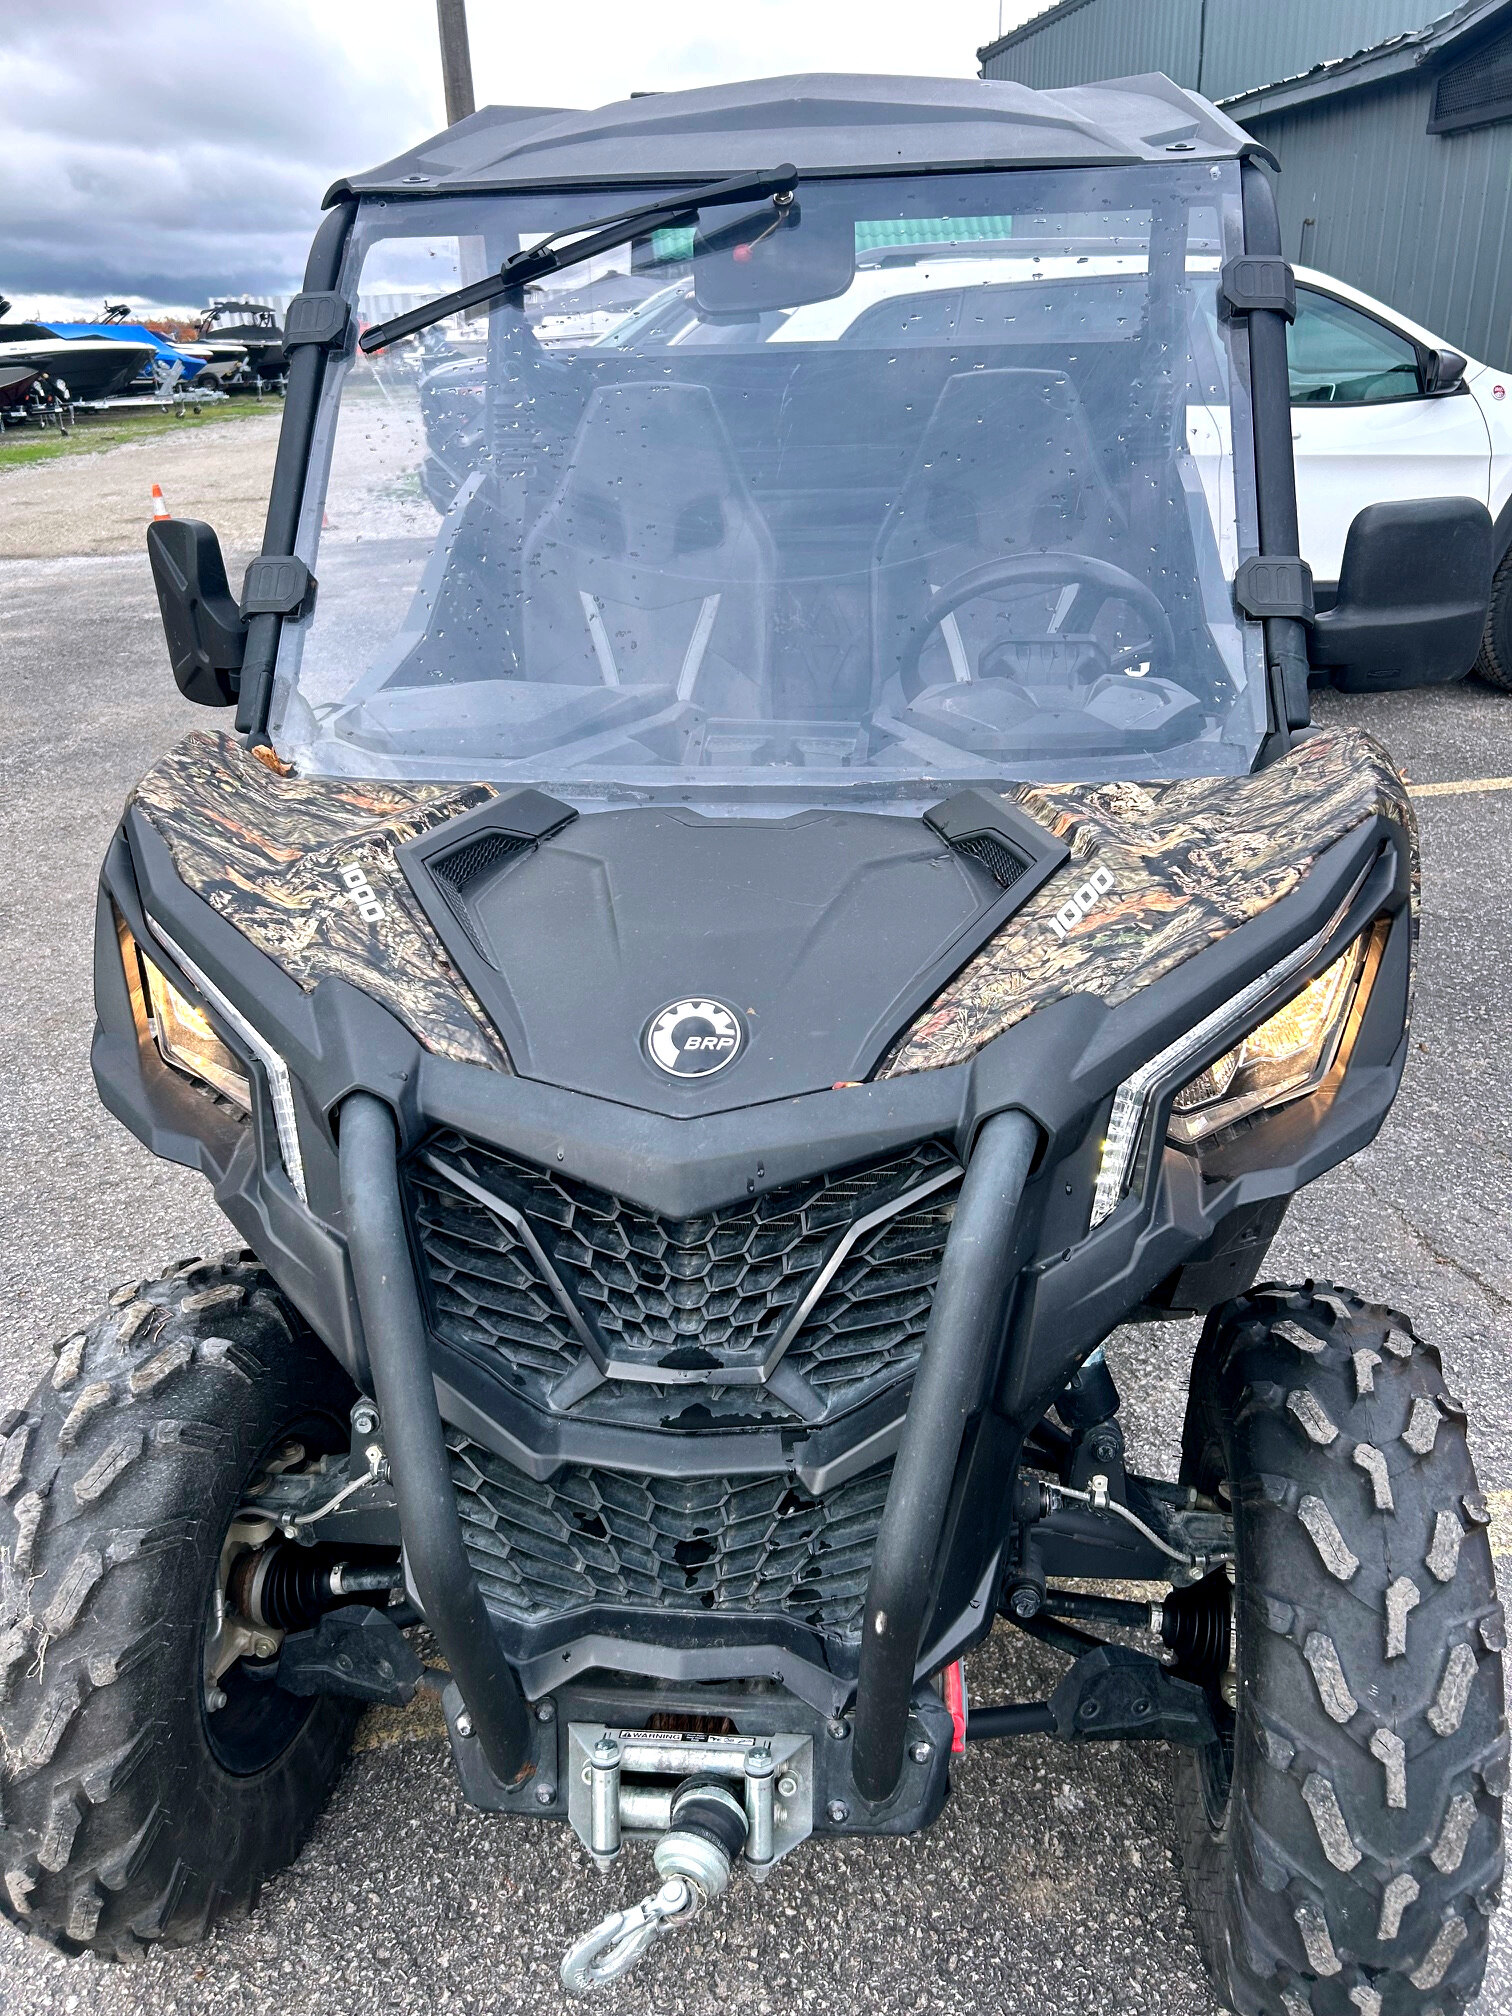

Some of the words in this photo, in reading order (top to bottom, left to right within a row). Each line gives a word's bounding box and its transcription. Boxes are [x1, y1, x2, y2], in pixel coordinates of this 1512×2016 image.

[340, 861, 385, 922] 1000
[1048, 866, 1114, 939] 1000
[684, 1036, 735, 1051] BRP
[633, 1732, 680, 1740] WARNING
